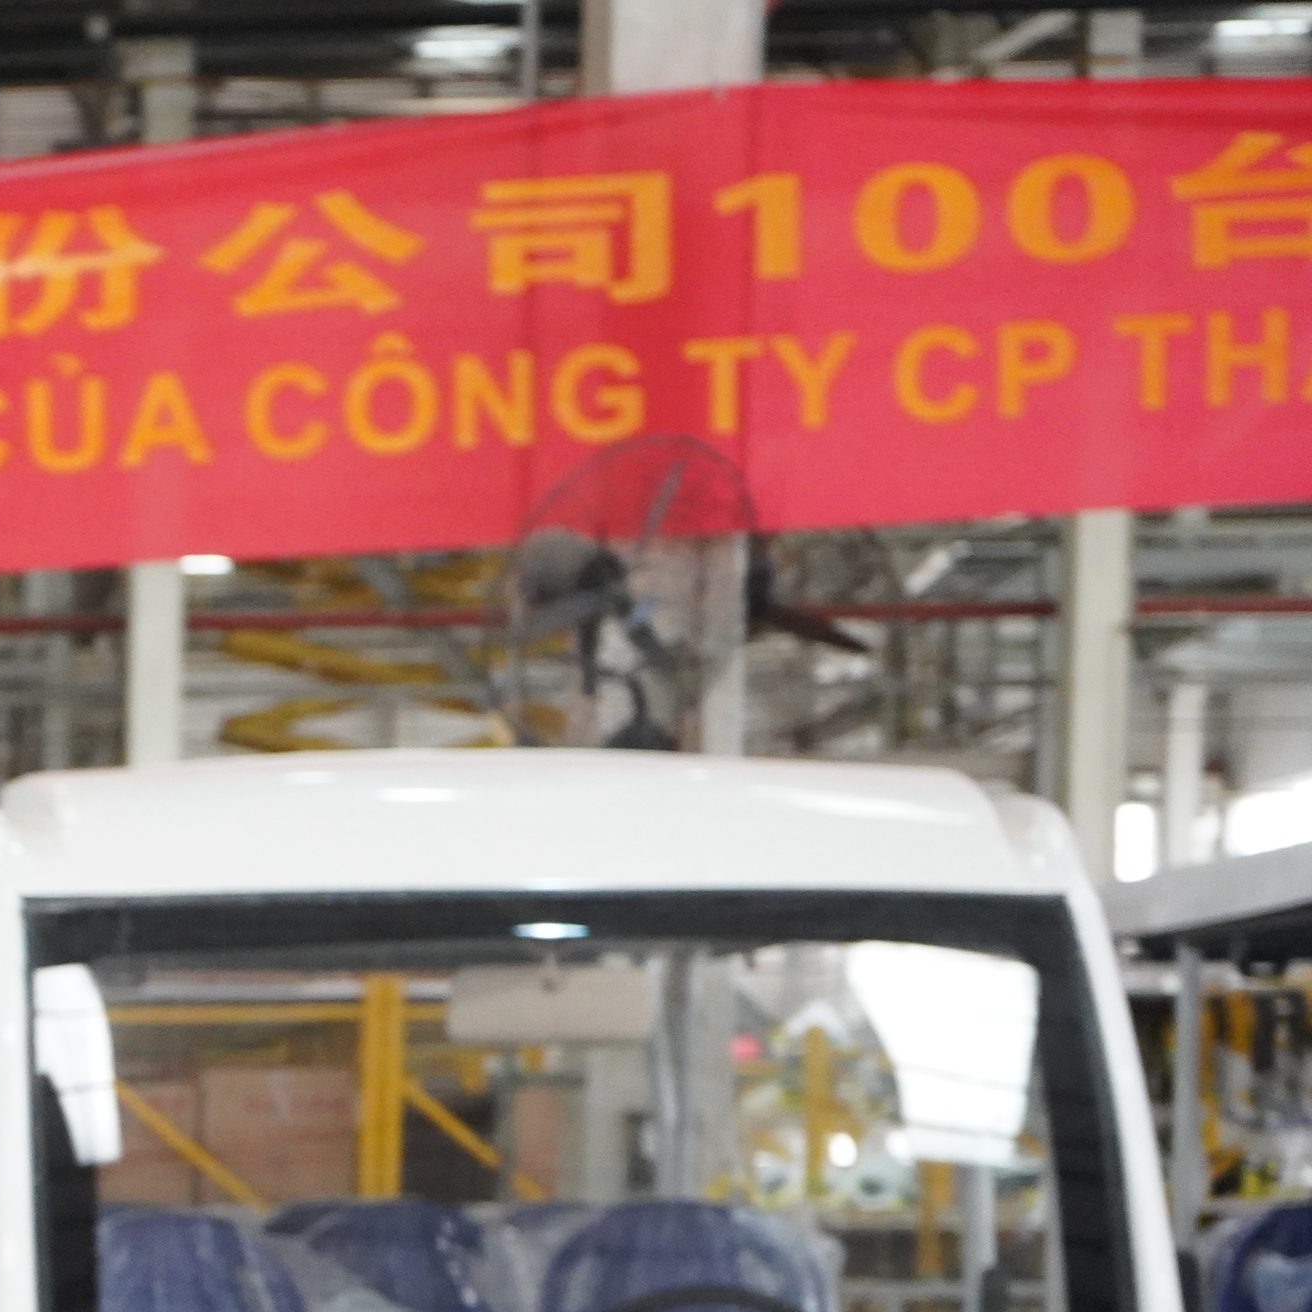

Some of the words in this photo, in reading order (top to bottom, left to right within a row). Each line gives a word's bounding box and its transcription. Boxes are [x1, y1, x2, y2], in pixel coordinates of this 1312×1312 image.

[243, 332, 645, 460] CÔNG
[682, 333, 854, 433] TY
[894, 321, 1076, 424] CP
[1114, 308, 1312, 409] TH
